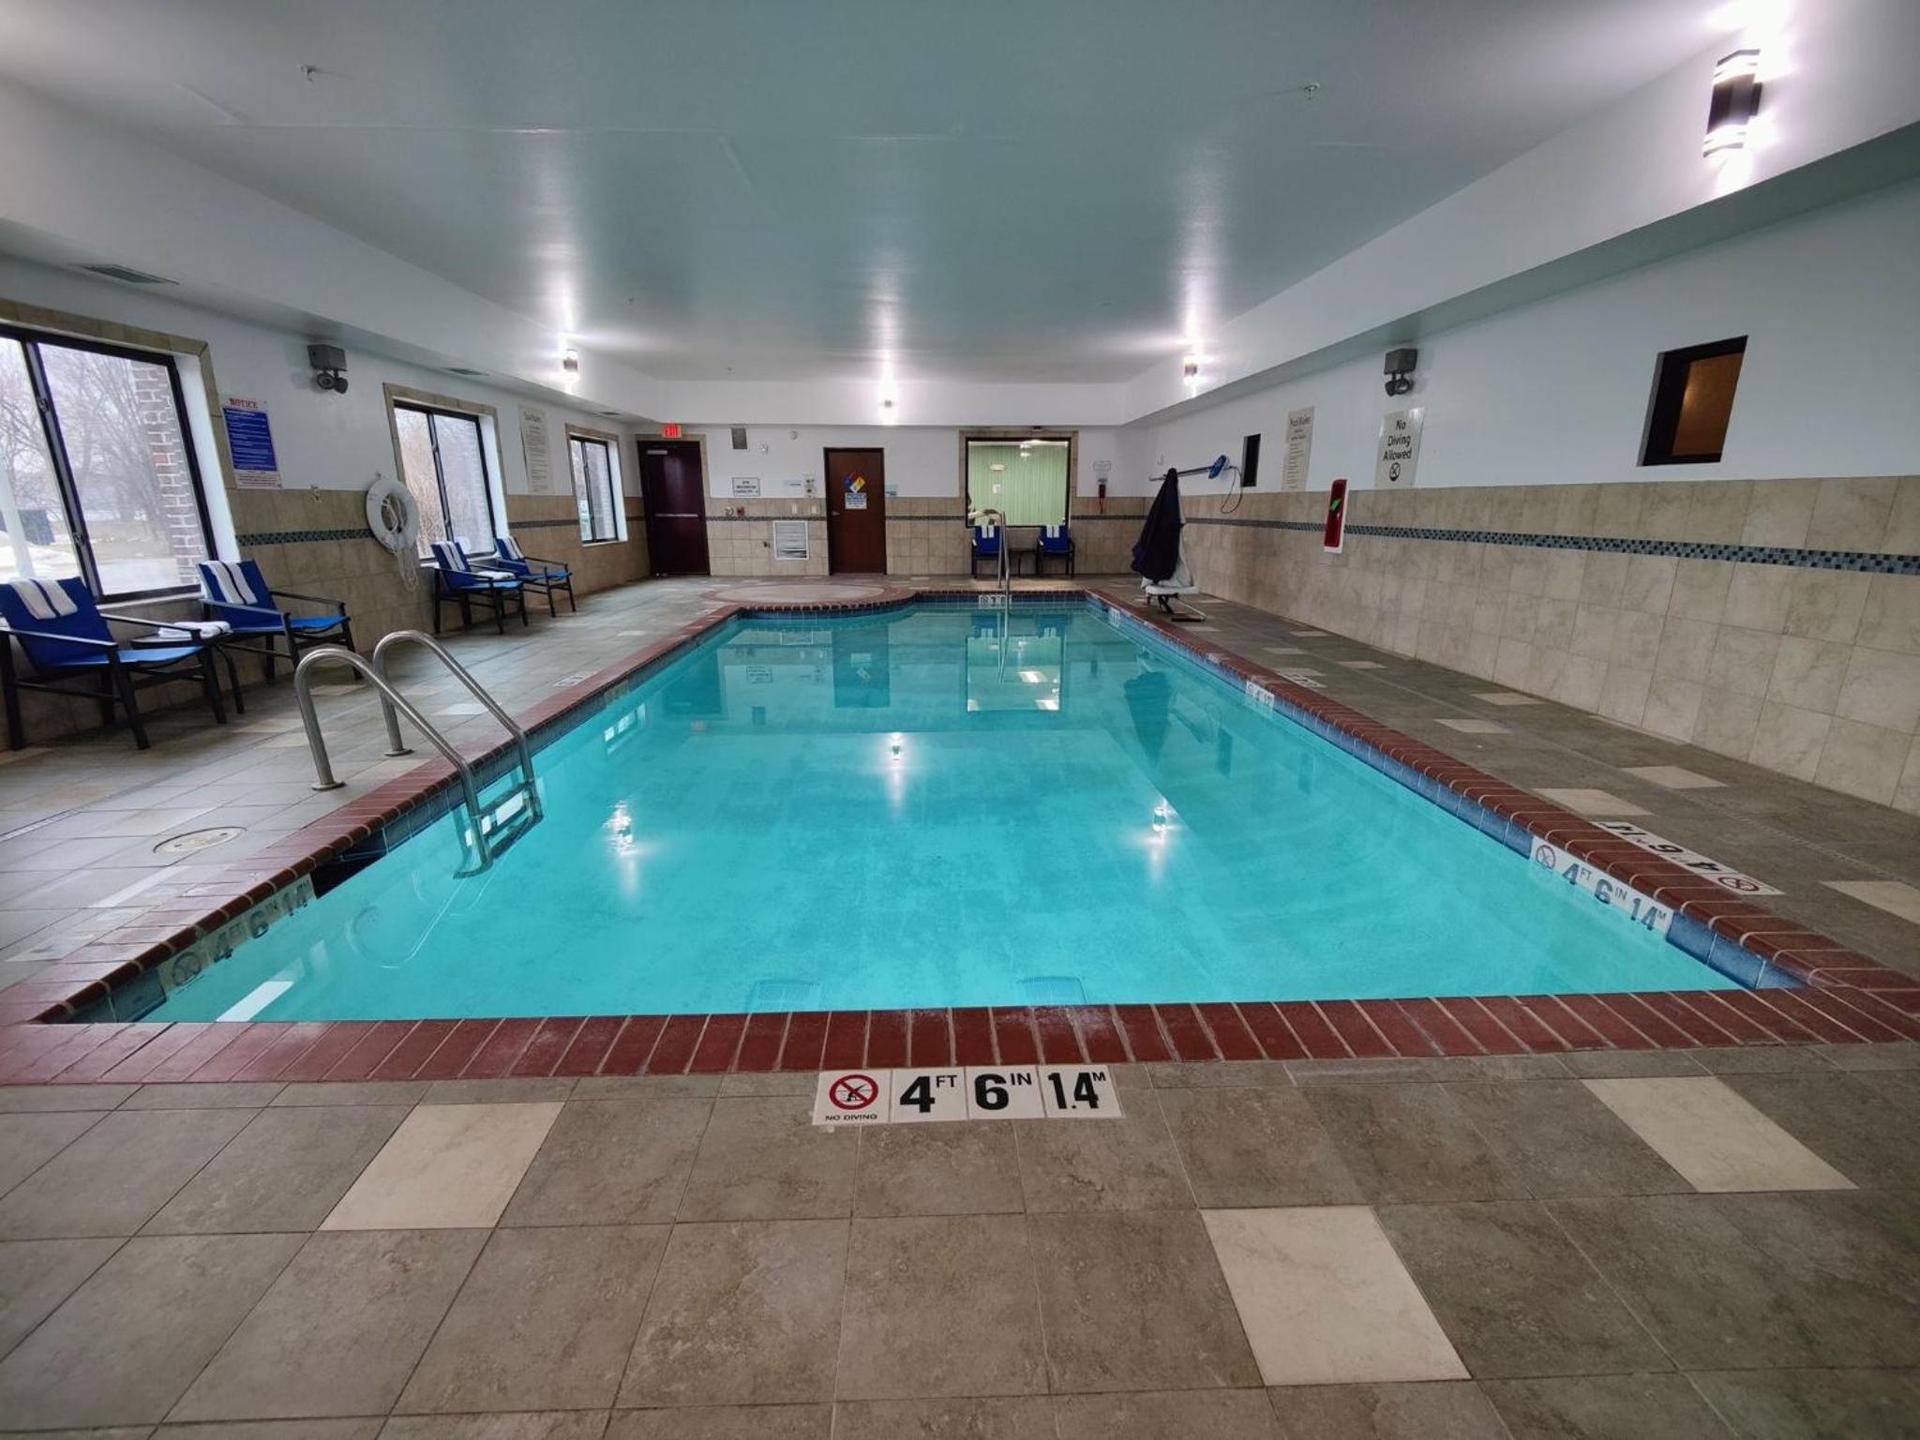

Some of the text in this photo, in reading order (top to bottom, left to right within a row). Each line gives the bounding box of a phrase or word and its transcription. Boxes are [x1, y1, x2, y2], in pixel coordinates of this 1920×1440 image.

[1396, 419, 1406, 430] No
[1388, 435, 1411, 447] Diving
[1383, 447, 1412, 461] Allowed
[843, 1113, 878, 1121] DIVING
